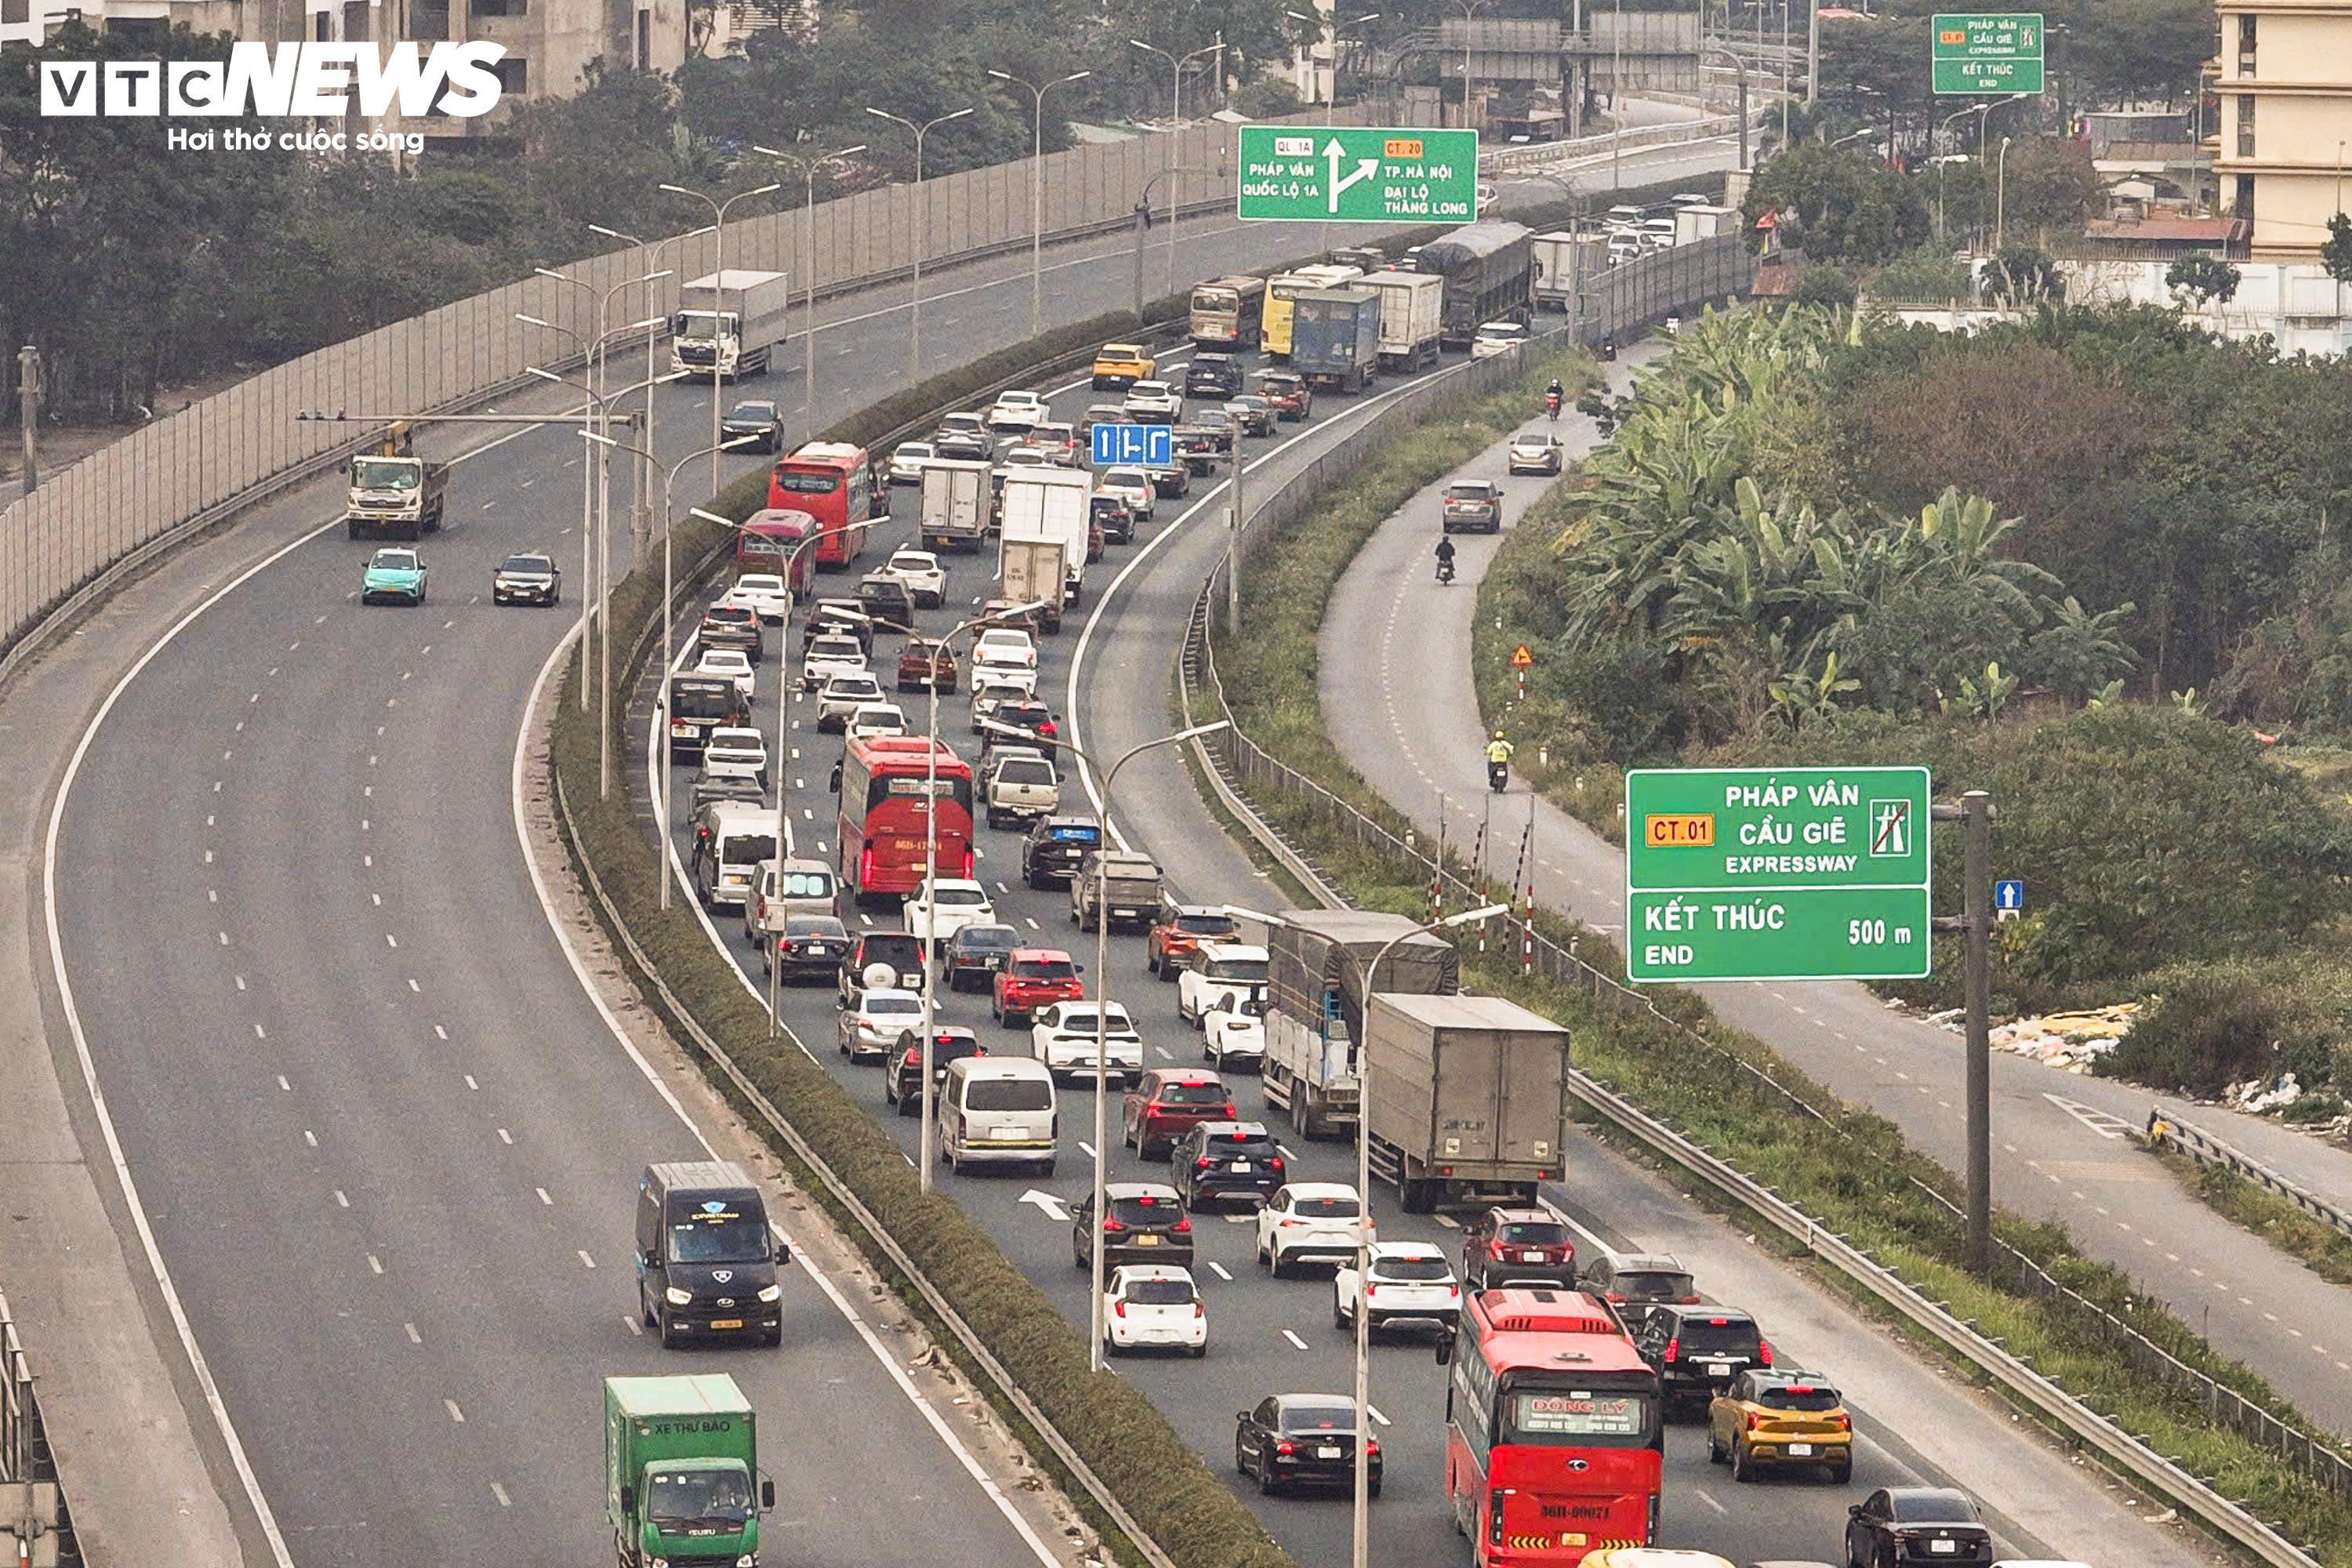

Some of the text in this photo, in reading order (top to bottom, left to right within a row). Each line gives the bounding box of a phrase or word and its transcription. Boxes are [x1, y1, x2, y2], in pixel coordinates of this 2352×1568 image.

[1968, 19, 2017, 31] PHÁP VÂN
[1973, 32, 1993, 44] CẦU
[1962, 62, 2013, 75] KẾT THÚC
[1250, 161, 1314, 176] PHÁP VÂN
[1429, 165, 1452, 182] NỘI
[1243, 181, 1319, 199] QUỐC LỘ 1A
[1385, 183, 1429, 201] ĐẠI LỘ
[1432, 202, 1468, 215] LONG
[1726, 779, 1859, 808] PHÁP VÂN
[1654, 821, 1708, 841] CT.01
[1740, 814, 1846, 845] CẦU GIẼ
[1726, 855, 1857, 874] EXPRESSWAY
[1645, 896, 1785, 931] KẾT THÚC
[1849, 920, 1911, 945] 500 m
[1645, 946, 1693, 965] END
[655, 1423, 670, 1435] XE
[673, 1421, 699, 1434] THƯ
